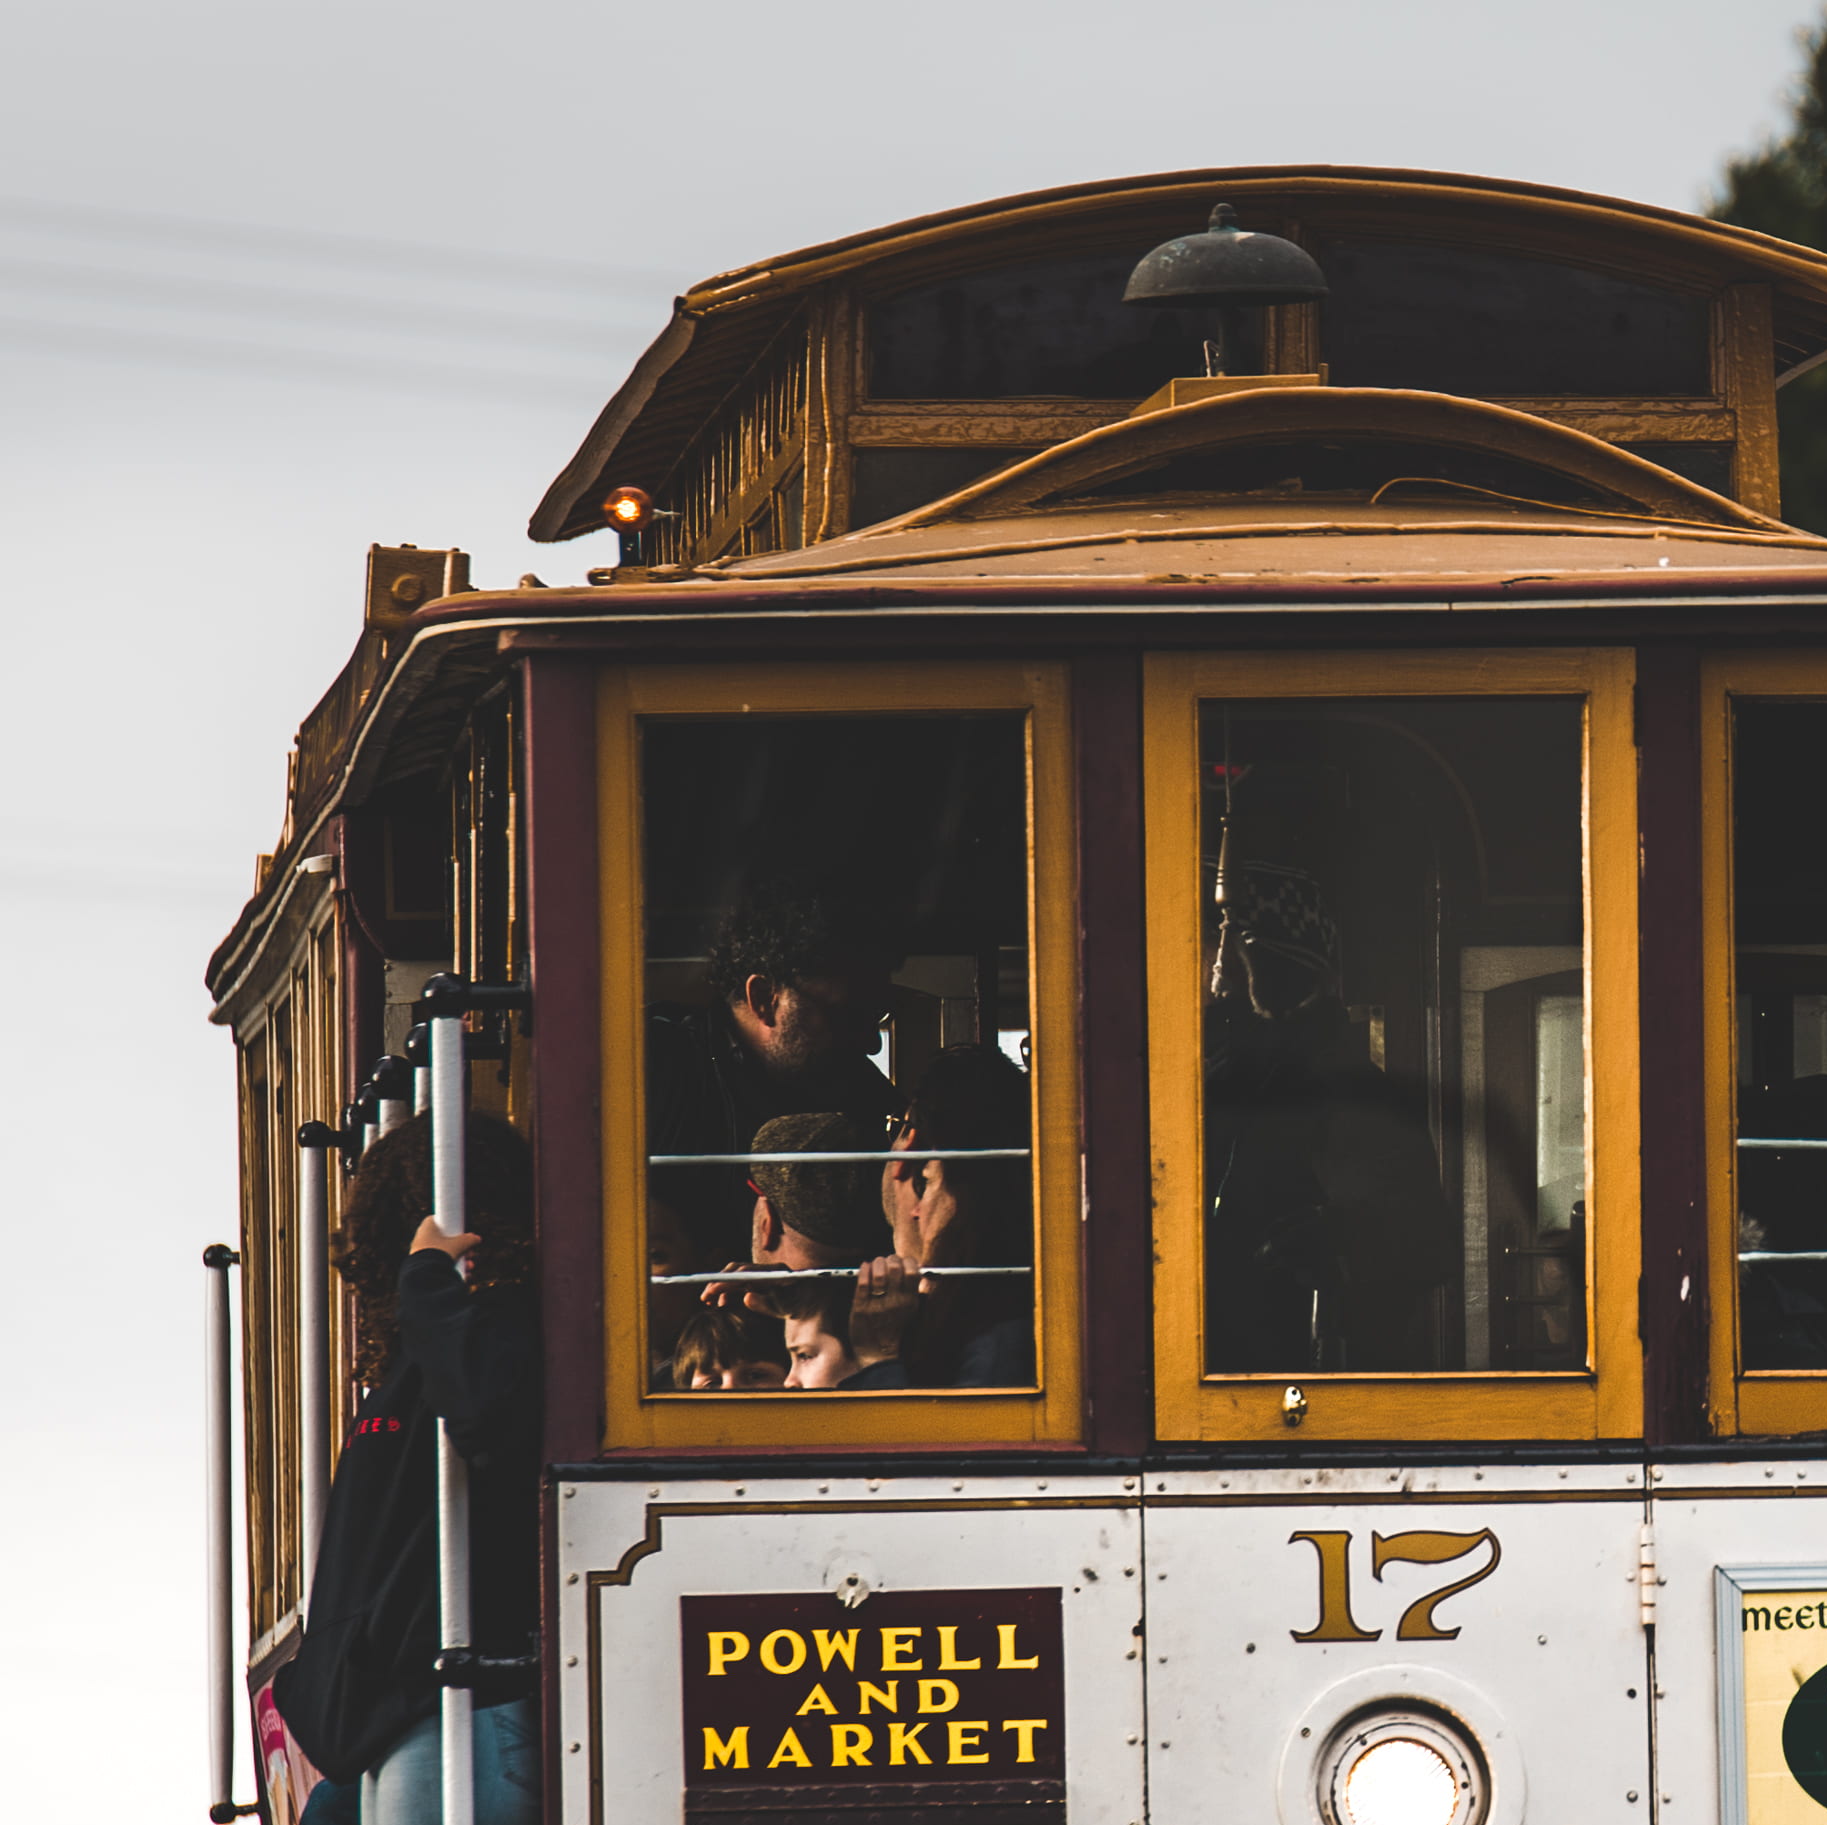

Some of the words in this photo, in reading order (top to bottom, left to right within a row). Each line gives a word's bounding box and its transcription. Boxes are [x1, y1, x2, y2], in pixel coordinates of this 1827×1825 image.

[1288, 1527, 1501, 1643] 17
[708, 1625, 1039, 1675] POWELL
[795, 1679, 959, 1715] AND
[702, 1720, 1047, 1769] MARKET
